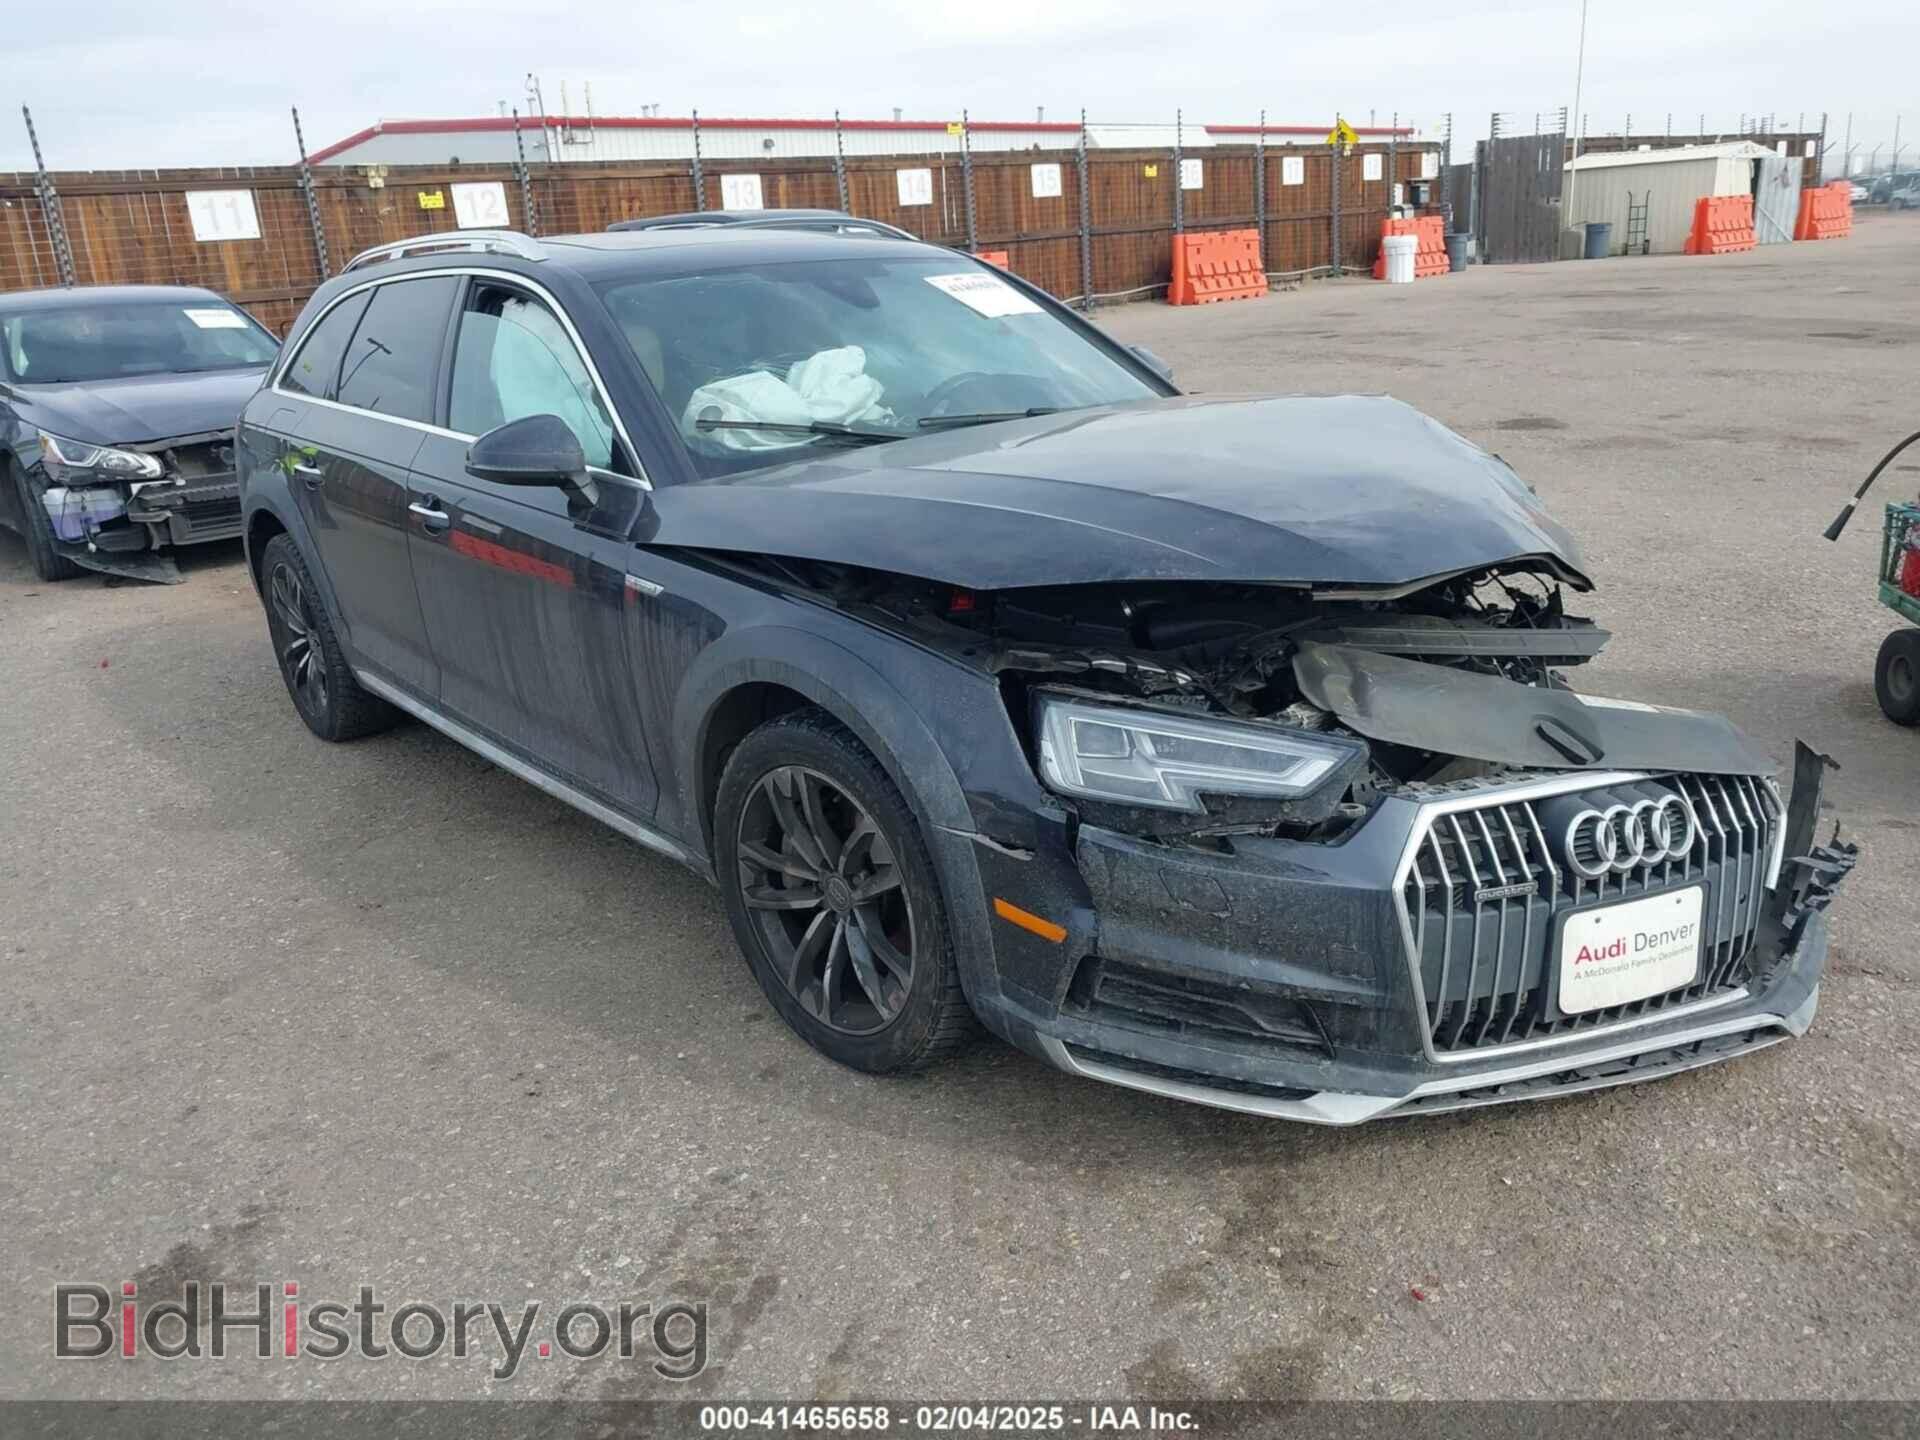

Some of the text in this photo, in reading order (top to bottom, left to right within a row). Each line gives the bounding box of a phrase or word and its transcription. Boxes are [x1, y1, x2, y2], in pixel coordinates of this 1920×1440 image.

[728, 180, 756, 208] 13
[905, 173, 929, 199] 14
[1036, 168, 1058, 192] 15
[201, 196, 242, 232] 11
[463, 189, 501, 222] 12
[1575, 923, 1694, 965] Audi Denver
[1573, 972, 1582, 981] A
